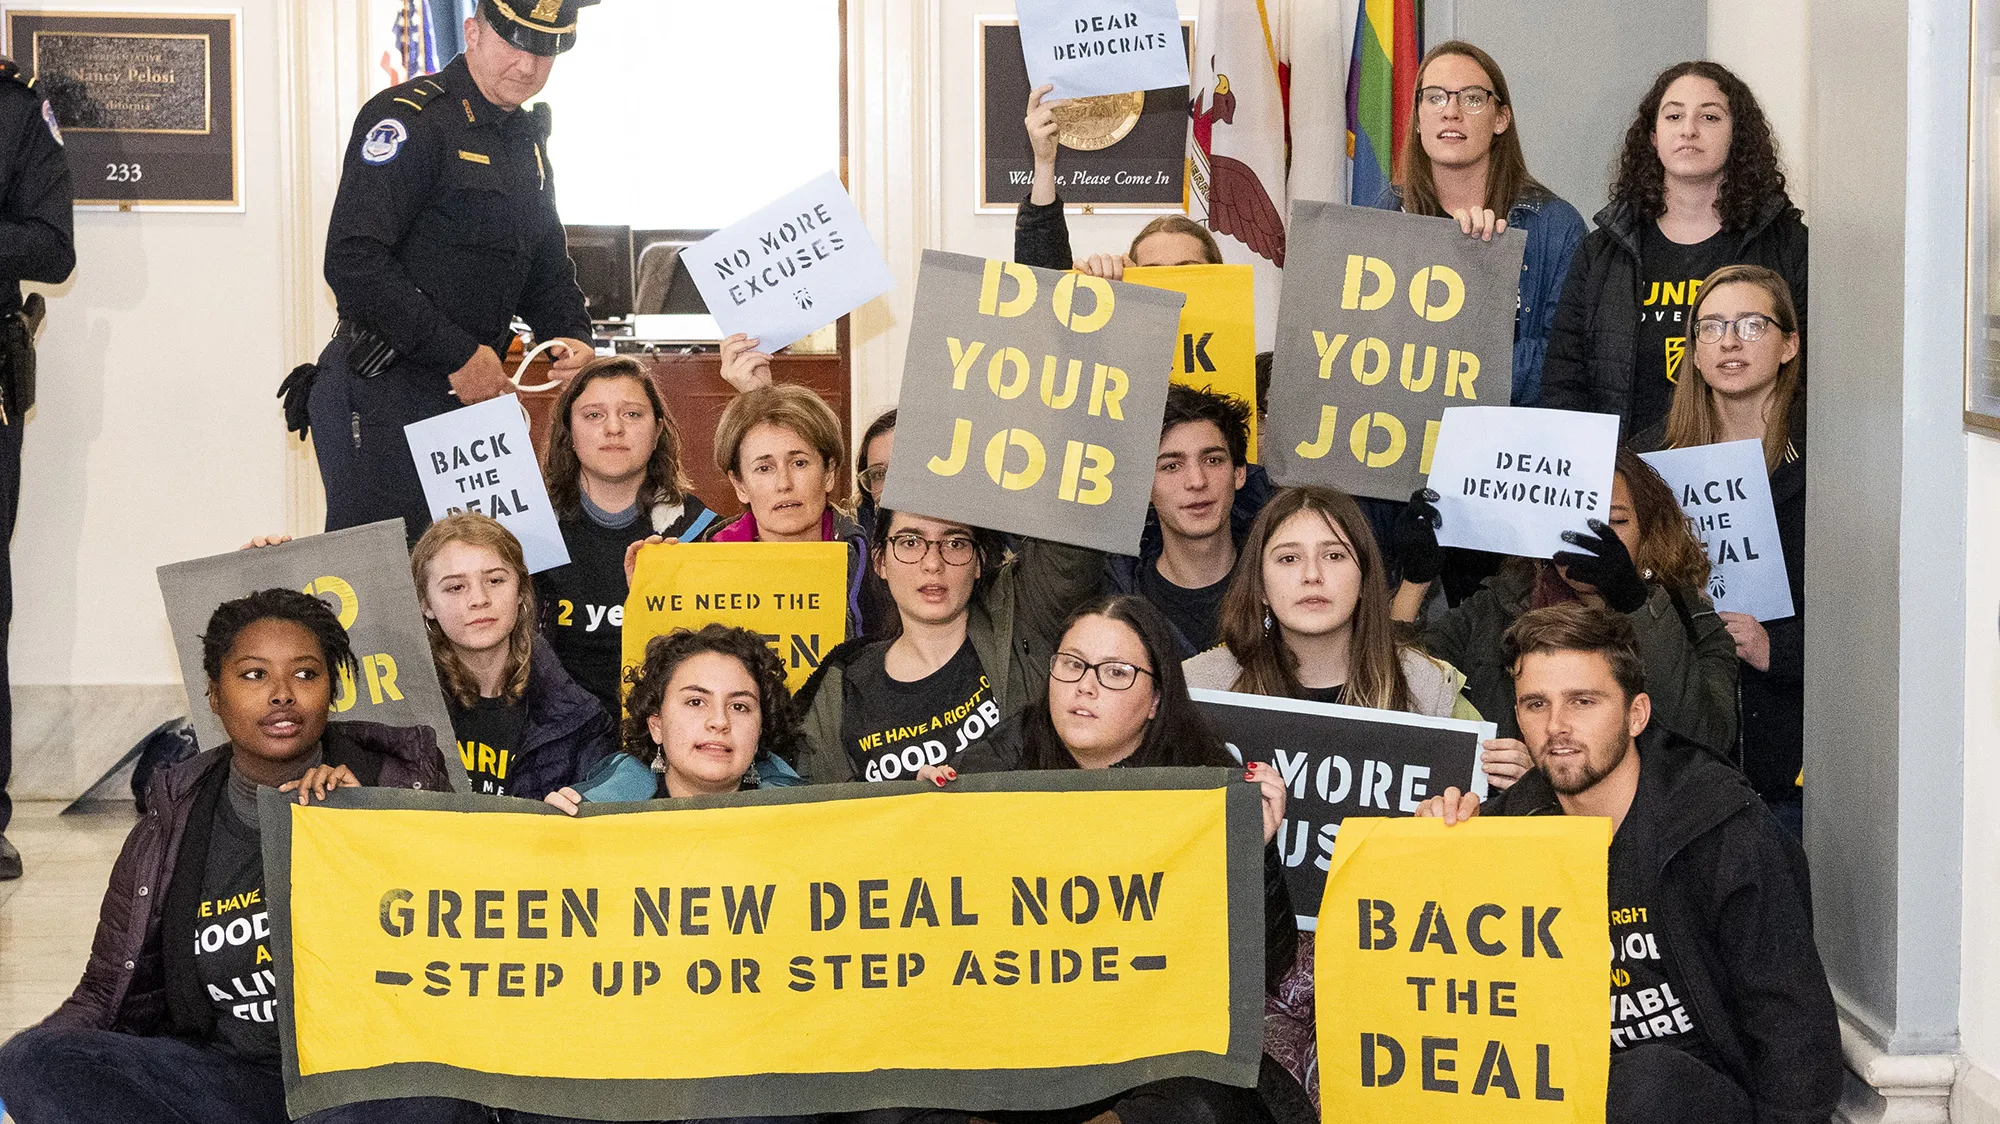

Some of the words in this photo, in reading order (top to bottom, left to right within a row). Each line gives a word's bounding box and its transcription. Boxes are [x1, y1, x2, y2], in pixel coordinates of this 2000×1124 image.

[1074, 12, 1139, 34] DEAR
[1053, 32, 1168, 61] DEMOCRATS
[127, 66, 176, 84] Pelosi
[105, 163, 143, 183] 233
[1008, 170, 1067, 187] Wele,
[1071, 170, 1111, 186] Please
[1114, 170, 1153, 186] Come
[1155, 170, 1170, 185] In
[714, 248, 751, 280] NO
[759, 203, 832, 255] MORE
[728, 230, 845, 307] EXCUSES
[1341, 254, 1466, 322] DO
[978, 259, 1116, 334] DO
[946, 337, 1130, 421] YOUR
[1312, 330, 1481, 400] YOUR
[430, 432, 512, 475] BACK
[927, 418, 1116, 506] JOB
[1496, 452, 1572, 477] DEAR
[455, 468, 500, 494] THE
[1463, 477, 1599, 511] DEMOCRATS
[1682, 477, 1748, 507] ACK
[1699, 512, 1732, 532] HE
[557, 599, 575, 627] 2
[645, 595, 683, 612] WE
[696, 593, 761, 610] NEED
[773, 593, 821, 610] THE
[858, 732, 883, 752] WE
[885, 722, 928, 744] HAVE
[931, 716, 943, 730] A
[943, 690, 981, 726] RIGHT
[865, 740, 948, 783] GOOD
[1272, 748, 1431, 814] MORE
[217, 888, 261, 915] HAVE
[378, 887, 599, 939] GREEN
[634, 884, 777, 937] NEW
[809, 876, 980, 932] DEAL
[1011, 871, 1165, 926] NOW
[1357, 898, 1565, 959] BACK
[207, 983, 234, 1002] A
[423, 960, 565, 998] STEP
[591, 960, 662, 997] UP
[685, 958, 762, 996] OR
[787, 952, 926, 993] STEP
[951, 946, 1119, 988] ASIDE
[1610, 968, 1632, 988] ND
[1406, 976, 1518, 1018] THE
[1360, 1032, 1565, 1102] DEAL
